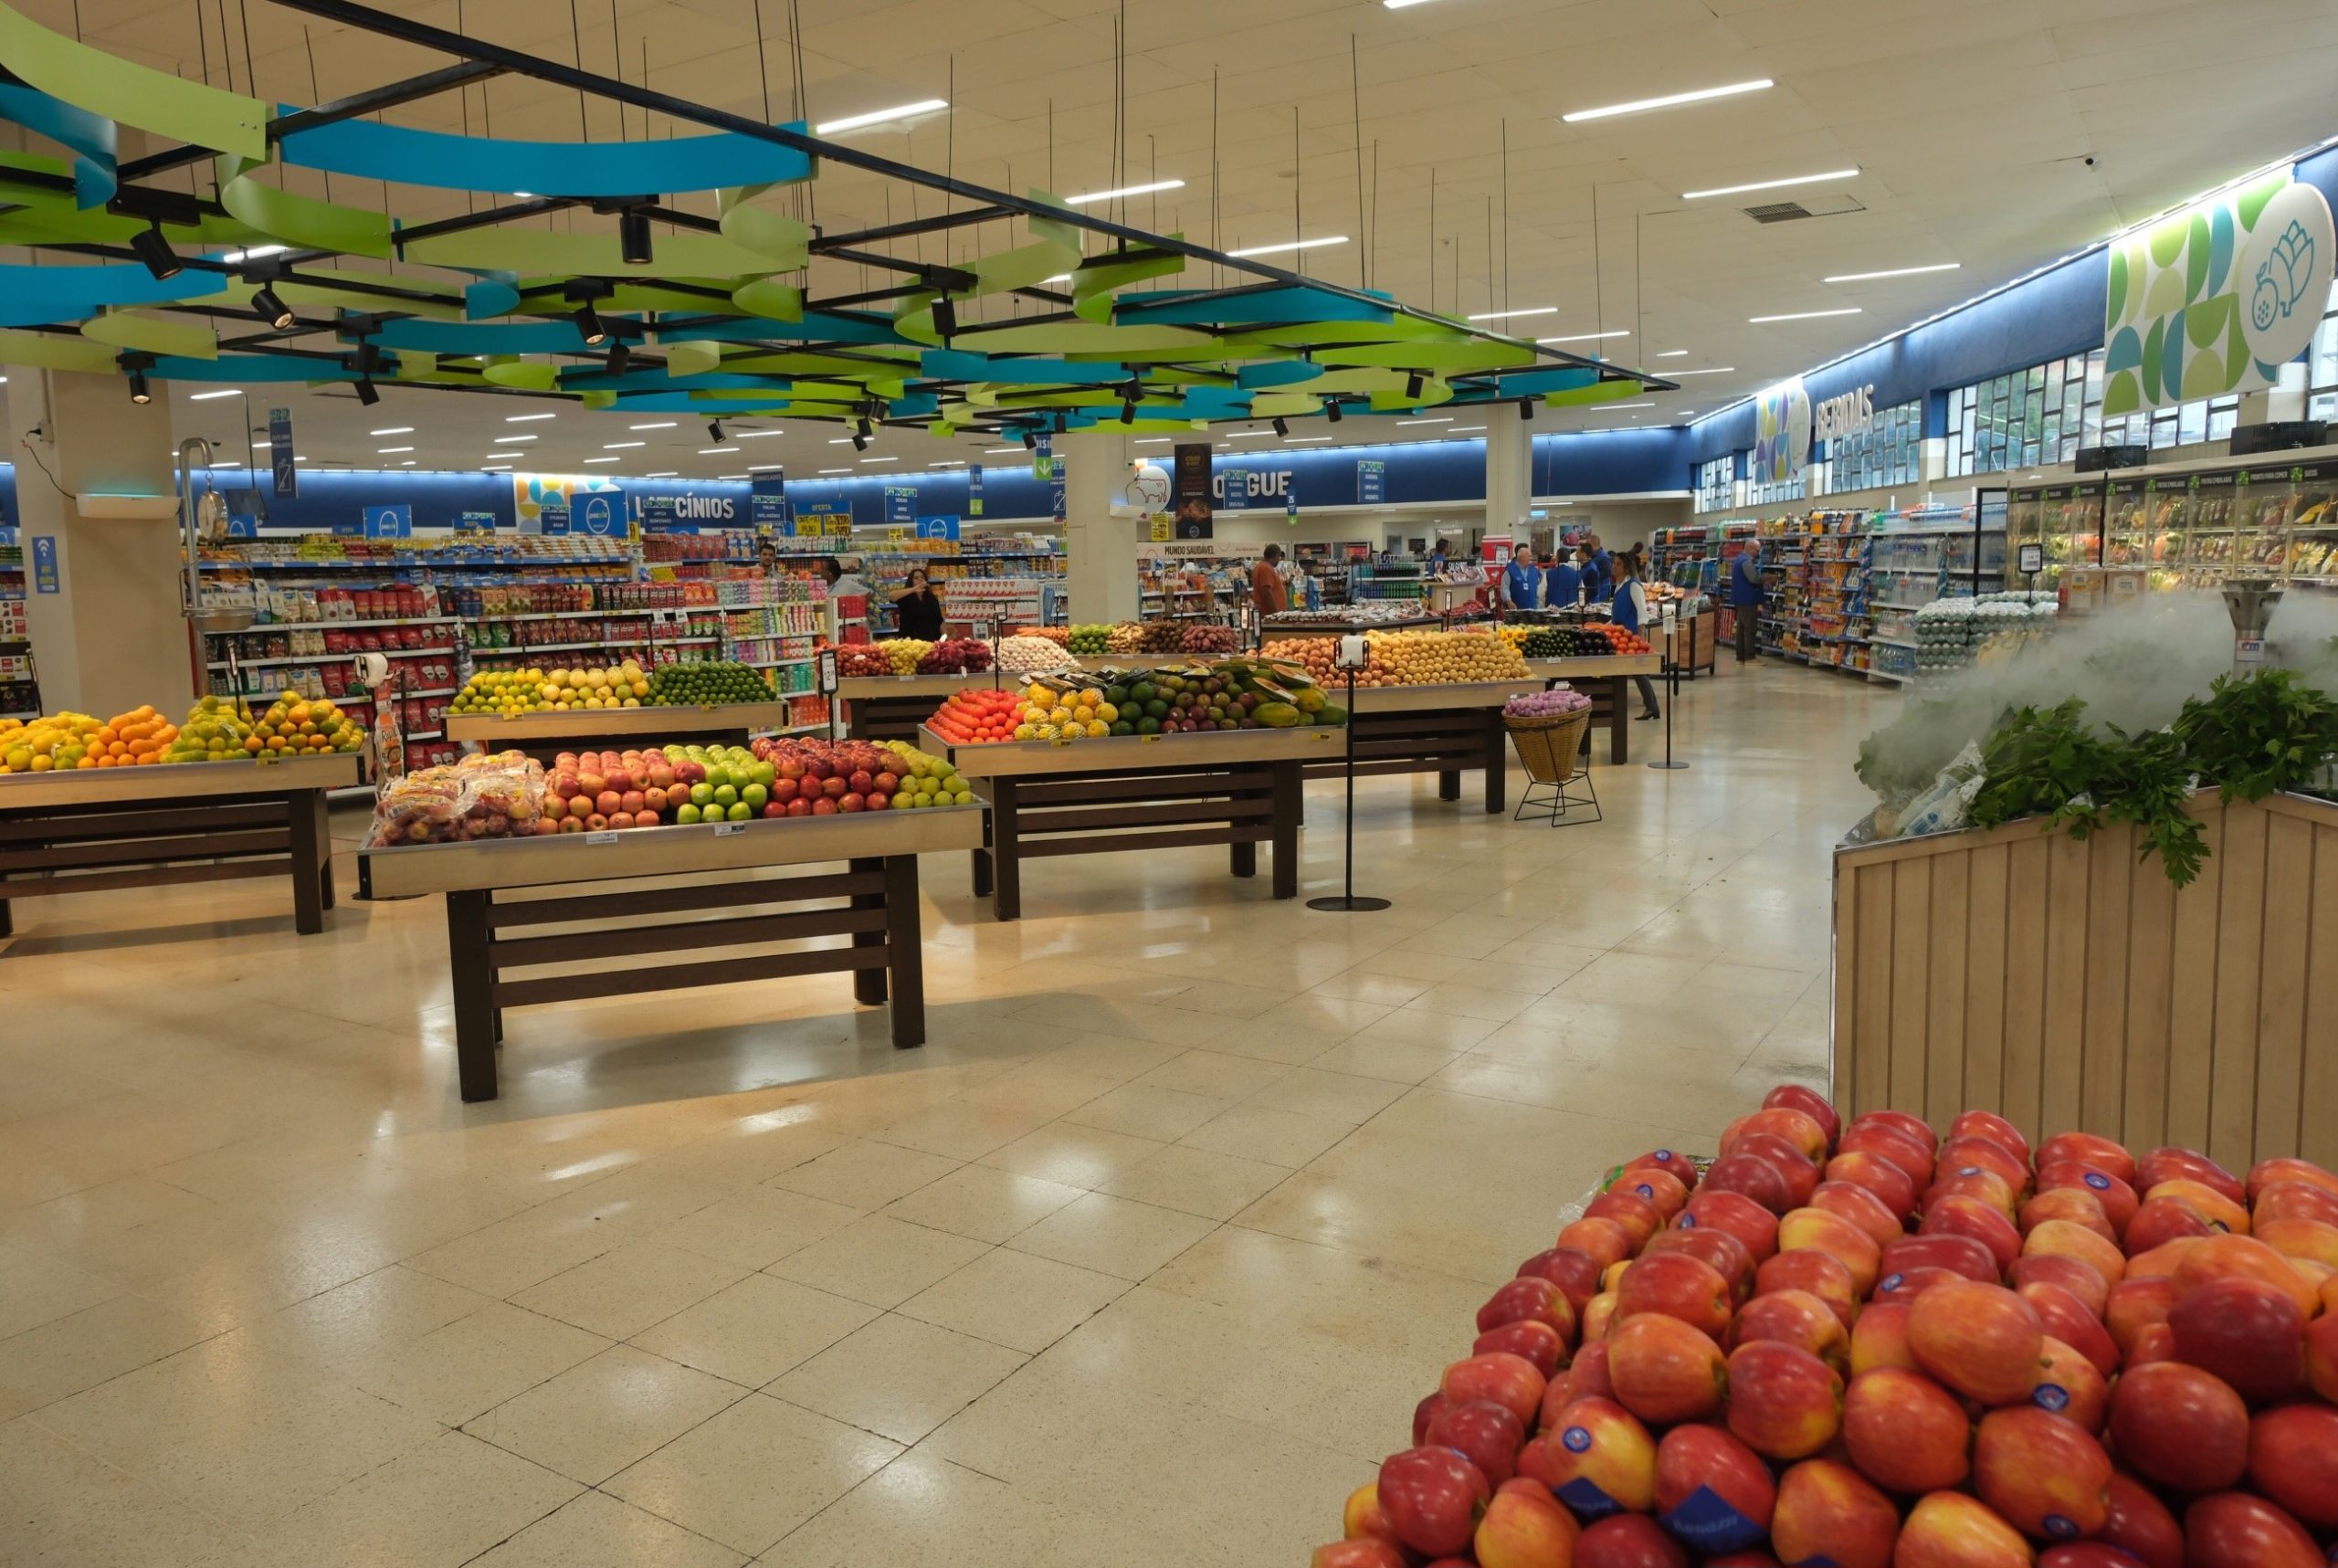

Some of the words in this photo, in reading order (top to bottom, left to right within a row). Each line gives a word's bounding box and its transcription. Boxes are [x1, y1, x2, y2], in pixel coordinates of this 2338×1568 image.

[1815, 384, 1874, 442] BEBIDAS
[1213, 471, 1292, 499] OGUE
[635, 491, 735, 519] LCÍNIOS
[1164, 545, 1186, 555] MUNDO
[1186, 543, 1215, 555] SAUDÁVEL
